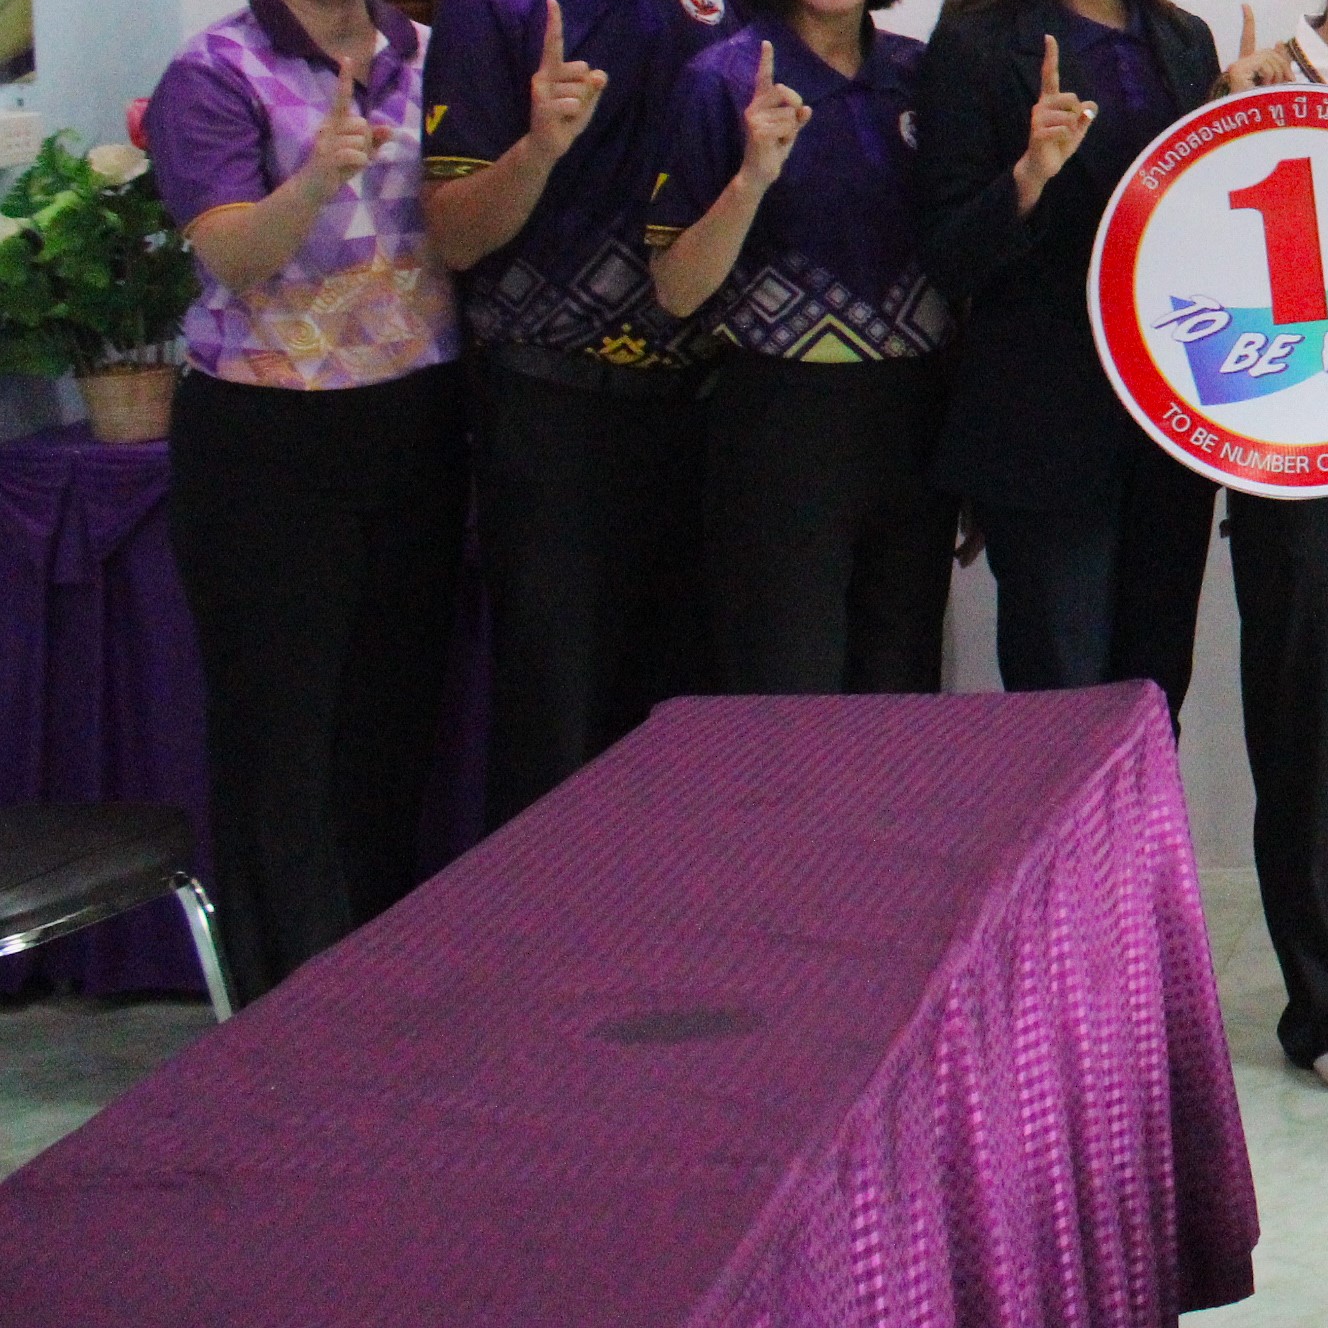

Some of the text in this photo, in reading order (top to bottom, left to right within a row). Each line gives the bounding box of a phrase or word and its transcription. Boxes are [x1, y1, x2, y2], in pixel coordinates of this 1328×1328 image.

[1139, 105, 1263, 191] อำเภอสองแคว
[1268, 103, 1285, 127] ทู
[1291, 96, 1308, 119] บี
[1151, 293, 1233, 343] TO
[1219, 332, 1306, 379] BE
[1162, 402, 1192, 433] TO
[1190, 427, 1221, 453] BE
[1220, 441, 1310, 473] NUMBER
